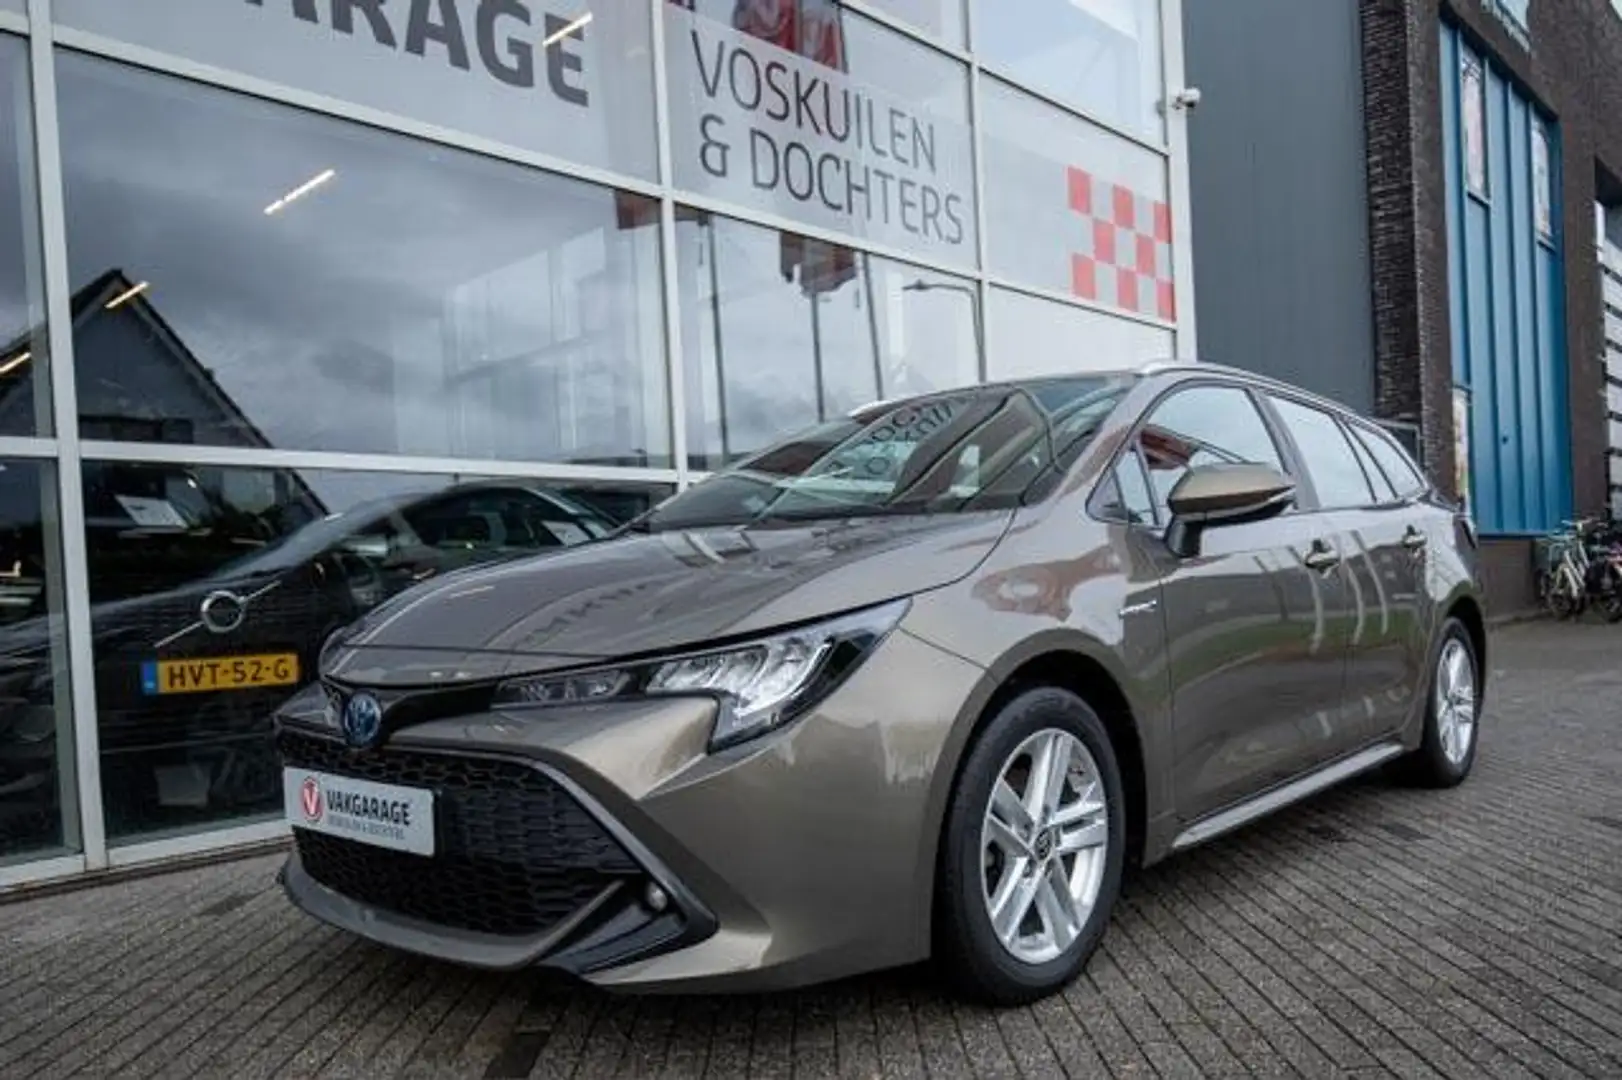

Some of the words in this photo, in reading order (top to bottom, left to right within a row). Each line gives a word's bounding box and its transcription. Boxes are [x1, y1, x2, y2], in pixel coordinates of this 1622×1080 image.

[243, 0, 589, 107] AGE
[692, 28, 936, 172] VOSKUILEN
[700, 112, 731, 178] &
[750, 127, 965, 246] DOCHTERS
[168, 657, 289, 688] HVT-52-G
[326, 789, 410, 826] VAKGARAGE
